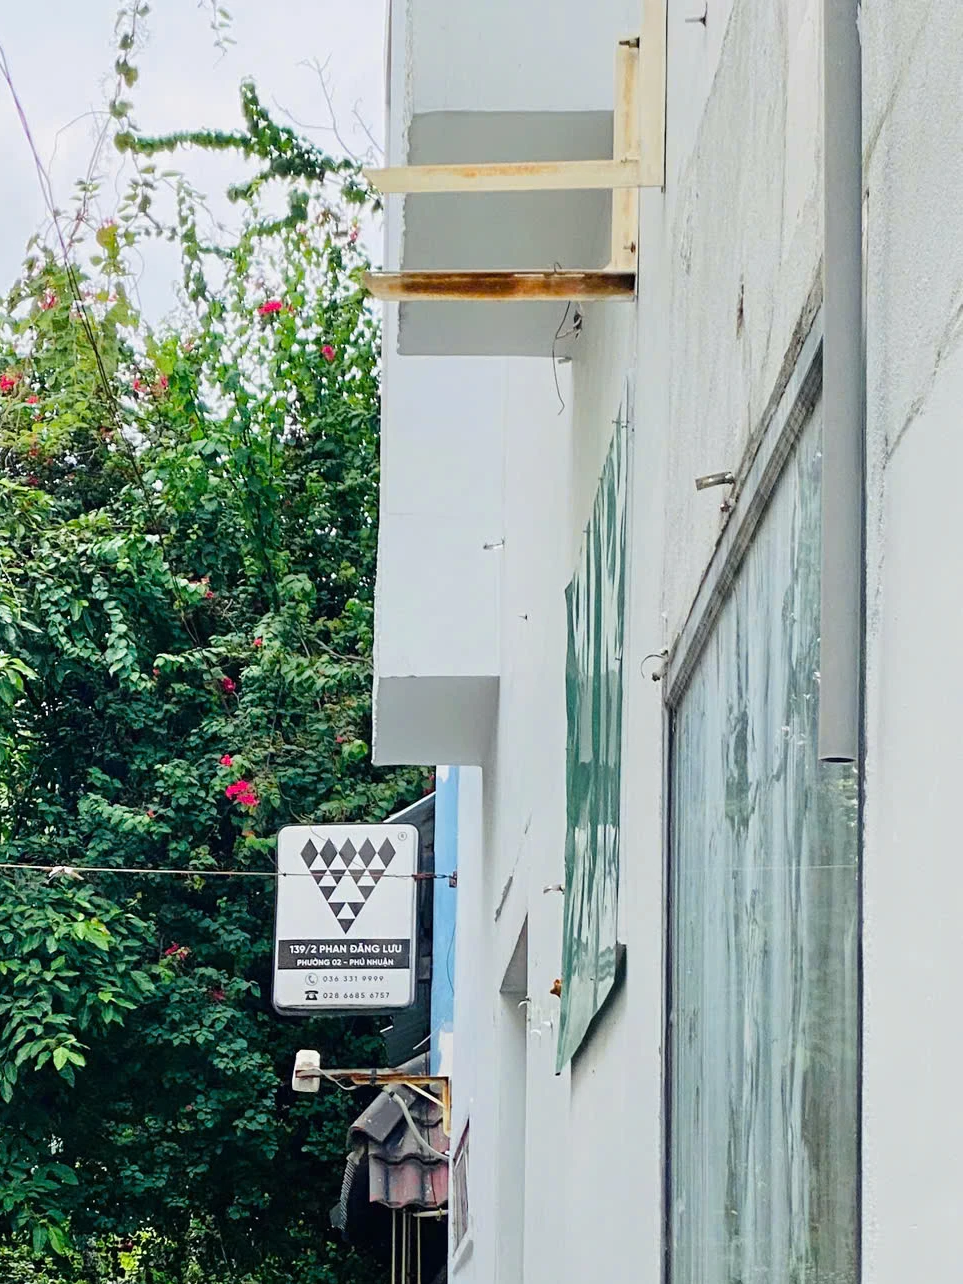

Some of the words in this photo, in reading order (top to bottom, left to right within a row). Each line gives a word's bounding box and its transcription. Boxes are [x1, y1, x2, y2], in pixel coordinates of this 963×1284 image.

[289, 944, 317, 954] 139/2
[319, 944, 347, 954] PHAN
[349, 942, 381, 954] ĐĂNG
[382, 943, 402, 953] LƯU
[349, 957, 365, 966] PHÚ
[366, 957, 394, 967] NHUẬN
